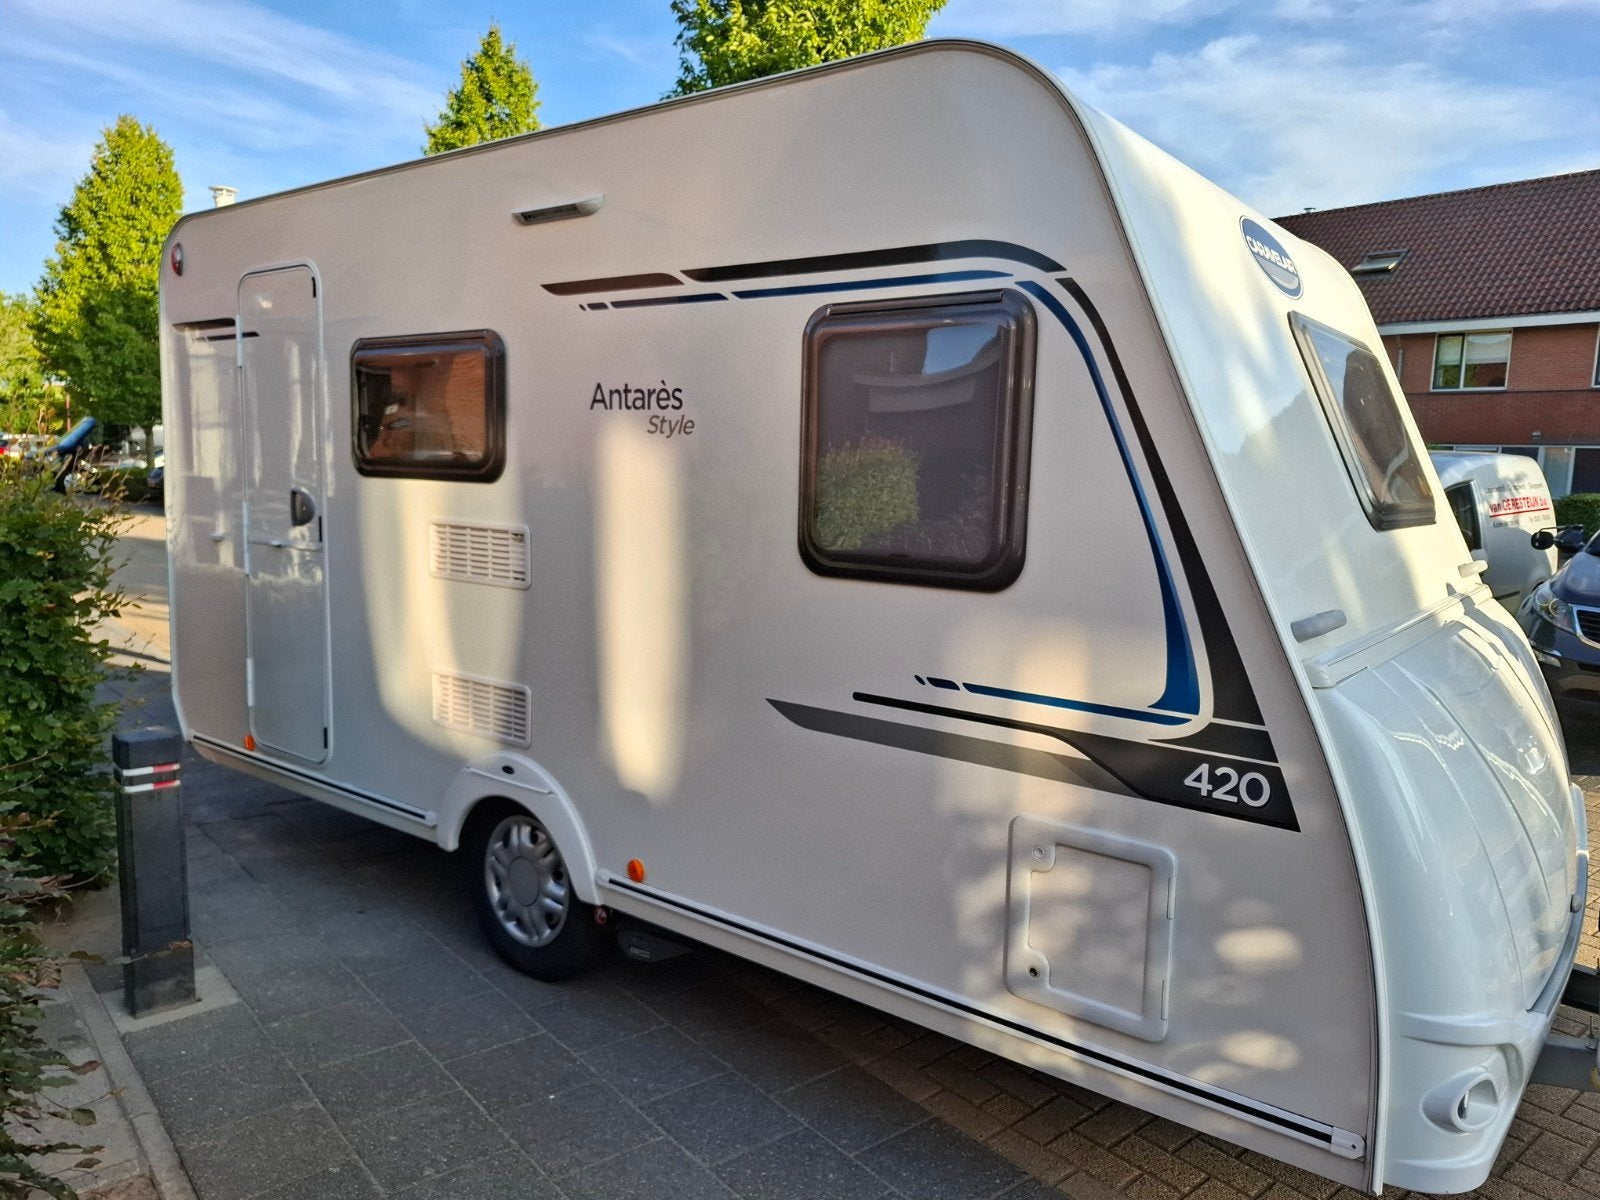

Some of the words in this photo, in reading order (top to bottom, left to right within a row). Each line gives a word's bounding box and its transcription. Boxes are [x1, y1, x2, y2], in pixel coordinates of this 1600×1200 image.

[589, 379, 684, 411] Antarès
[647, 414, 696, 439] Style
[1488, 502, 1502, 513] van
[1183, 762, 1271, 808] 420
